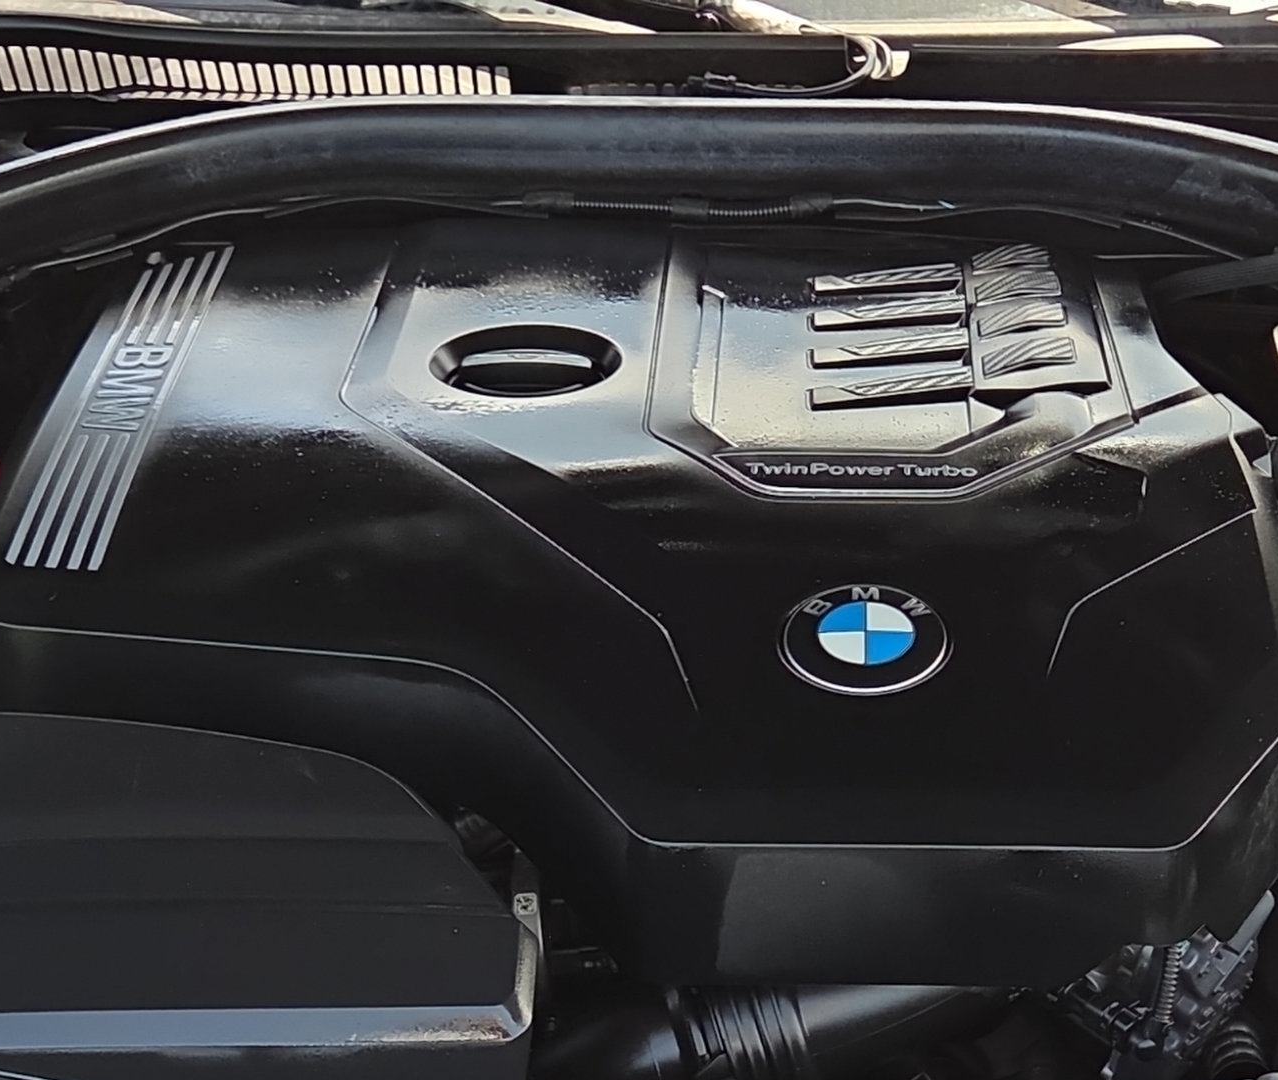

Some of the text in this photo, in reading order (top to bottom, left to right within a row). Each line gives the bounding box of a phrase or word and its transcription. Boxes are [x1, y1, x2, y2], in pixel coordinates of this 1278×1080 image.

[80, 346, 174, 432] BMW
[745, 462, 978, 477] TwinPower Turbo
[802, 586, 932, 617] BMW
